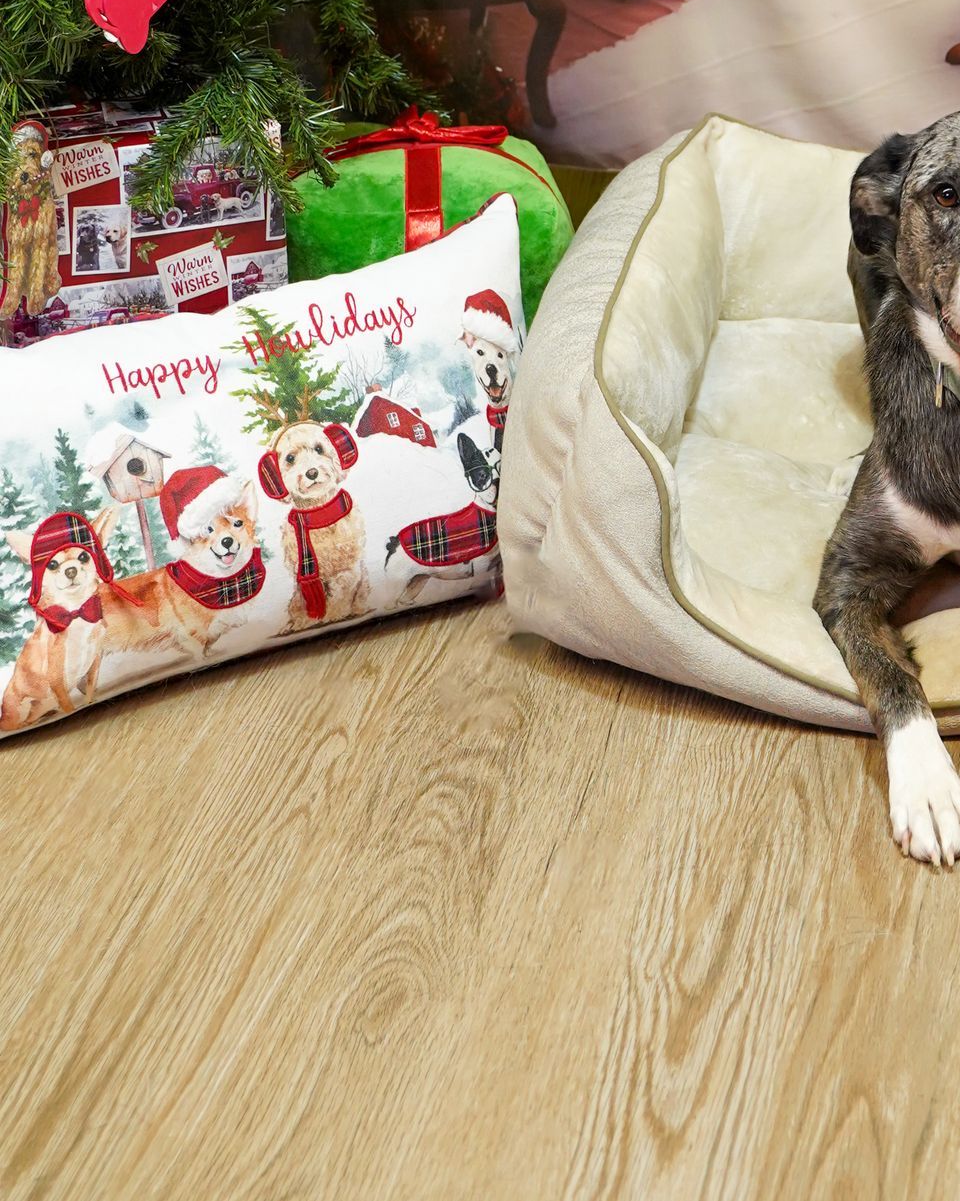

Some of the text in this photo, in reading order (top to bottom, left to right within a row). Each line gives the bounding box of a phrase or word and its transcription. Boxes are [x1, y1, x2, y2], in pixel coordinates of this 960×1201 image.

[56, 146, 104, 167] Warm
[61, 161, 111, 188] WISHES
[167, 255, 214, 277] Warm
[171, 270, 220, 297] WISHES
[101, 291, 417, 399] Happy Howlidays
